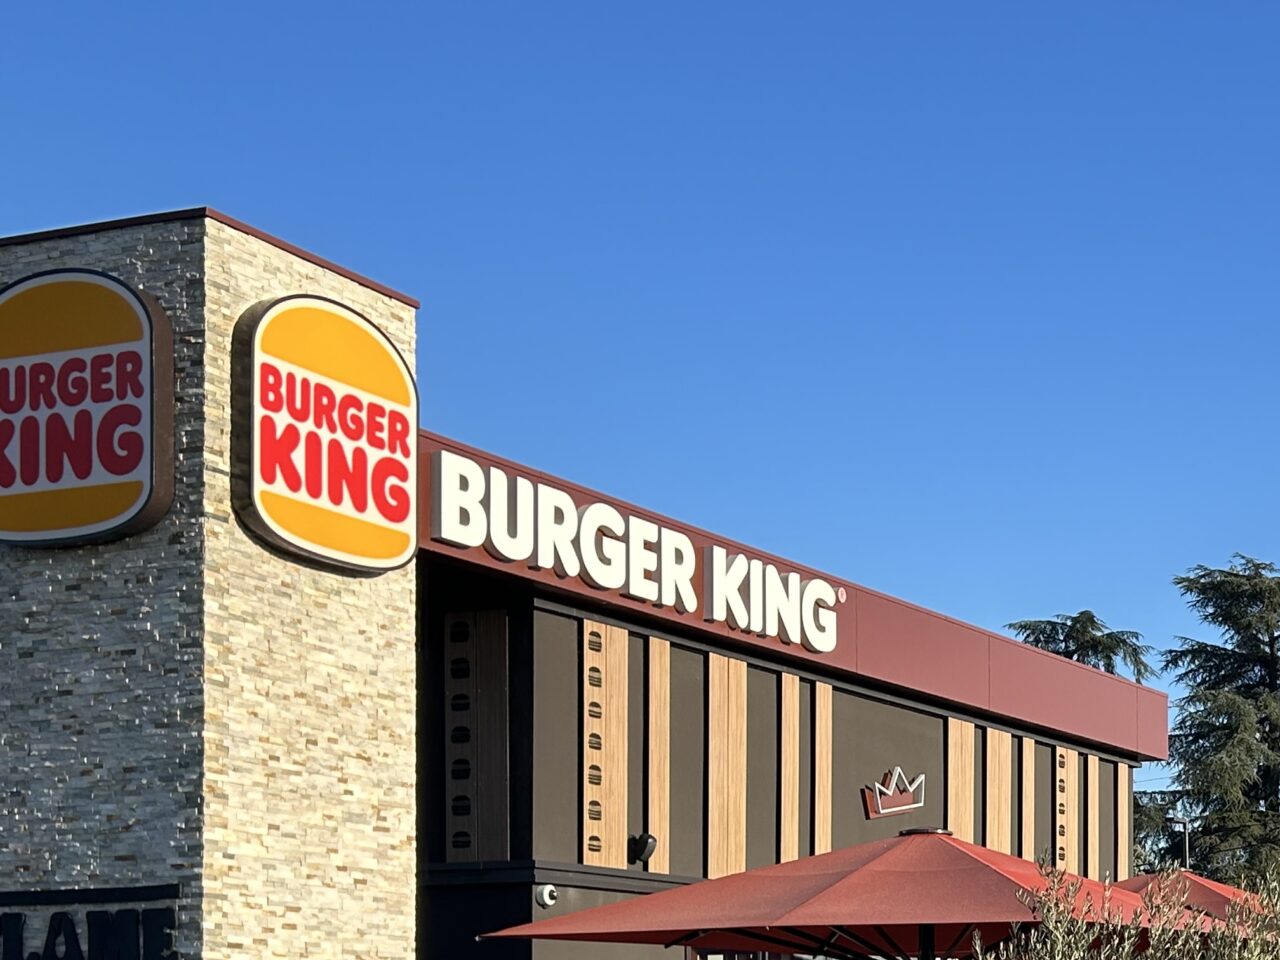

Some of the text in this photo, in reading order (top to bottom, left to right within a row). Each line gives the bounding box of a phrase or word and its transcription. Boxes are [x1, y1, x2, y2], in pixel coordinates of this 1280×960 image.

[0, 350, 144, 414] URGER
[260, 362, 411, 458] BURGER
[260, 415, 411, 523] KING
[437, 450, 698, 614] BURGER
